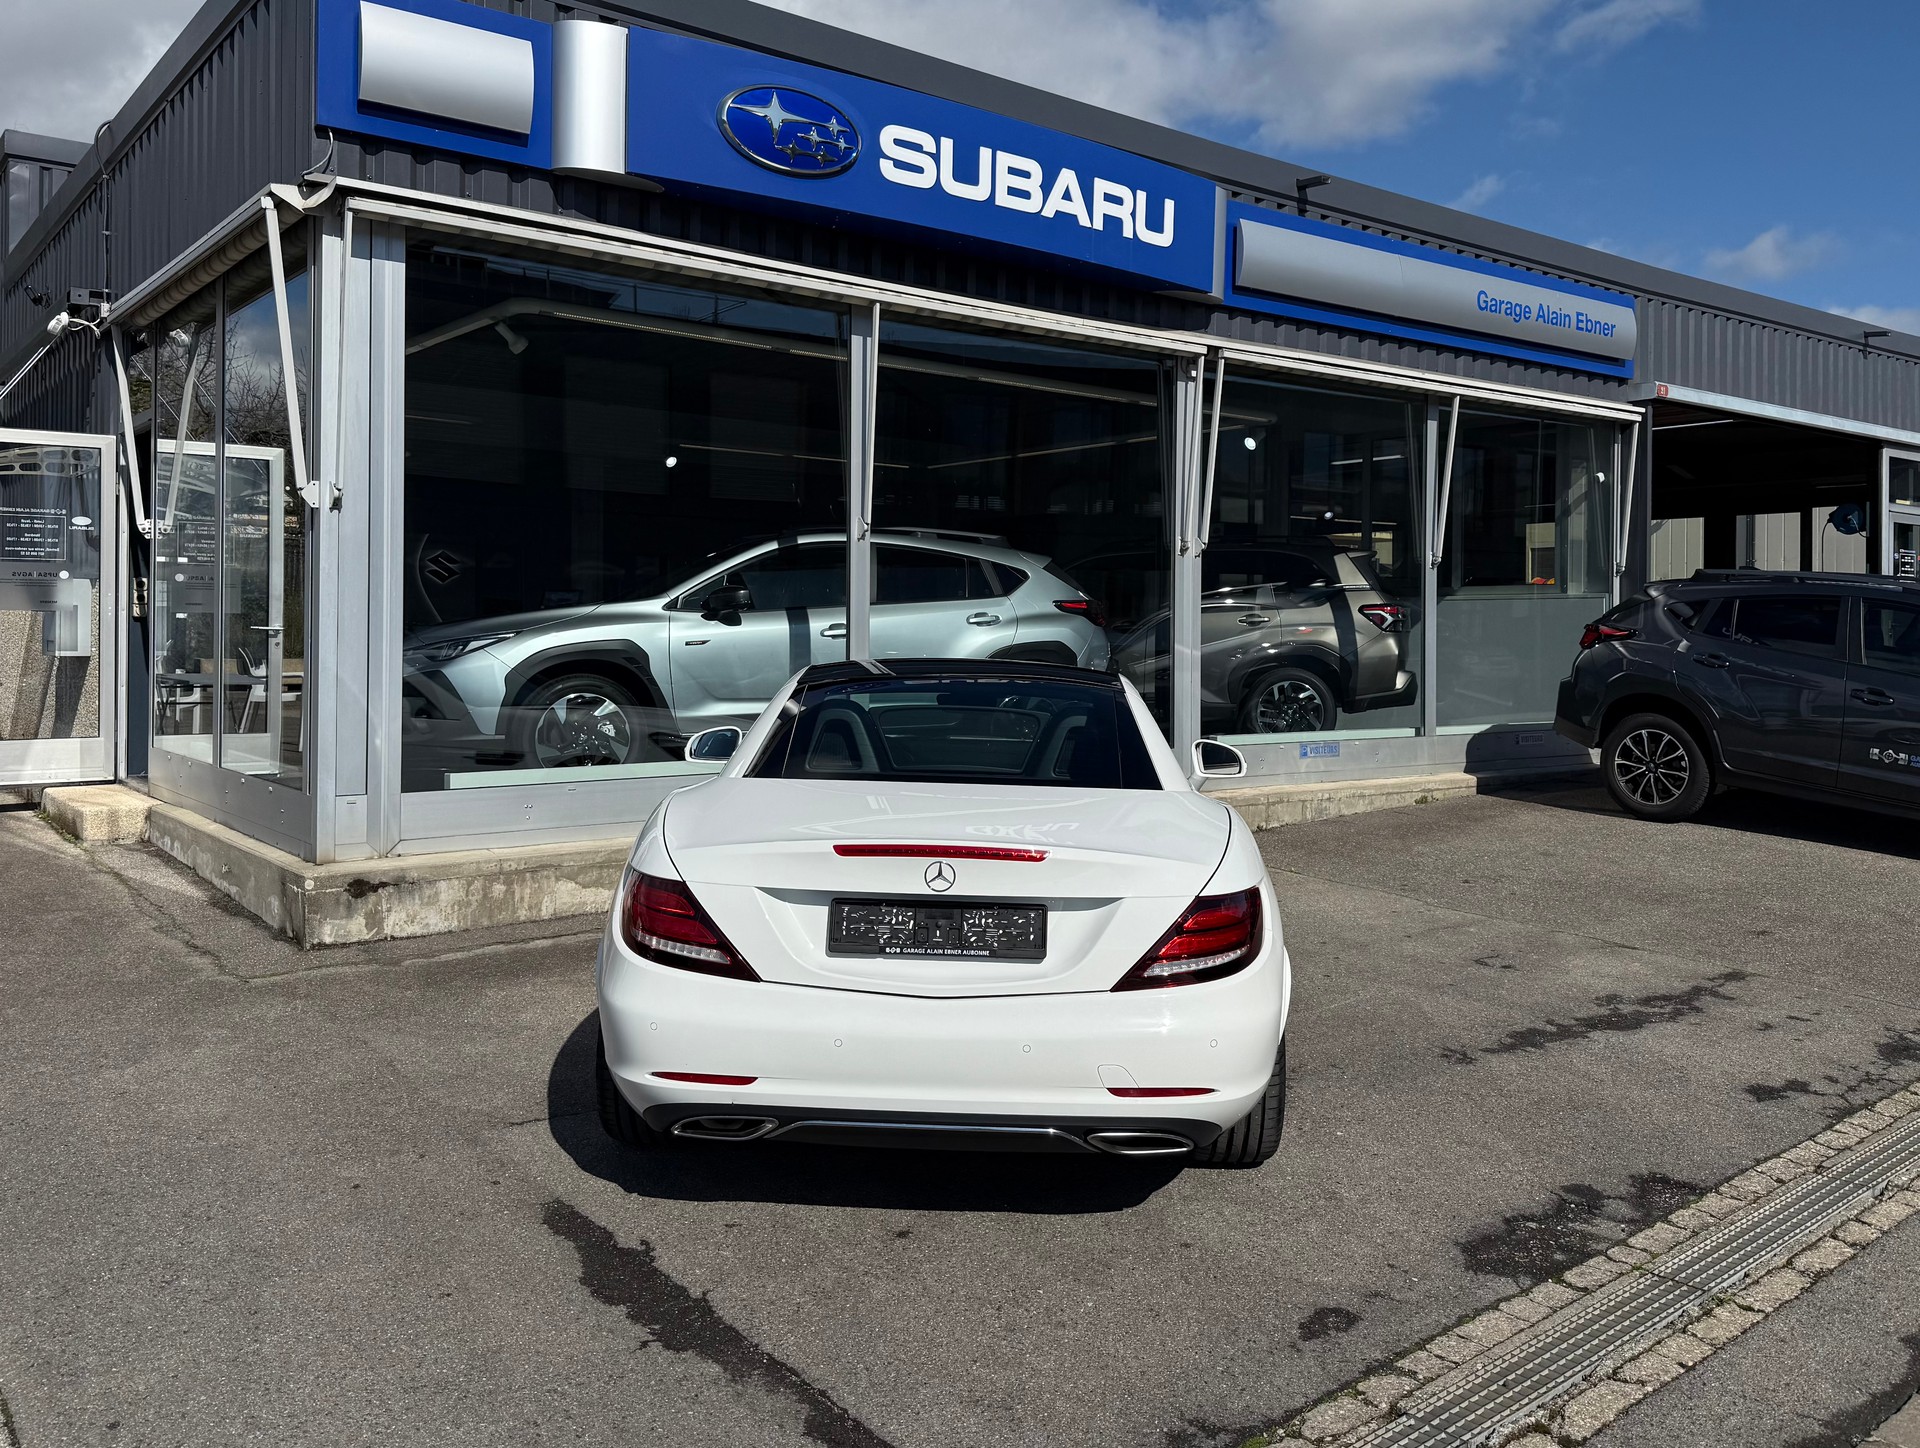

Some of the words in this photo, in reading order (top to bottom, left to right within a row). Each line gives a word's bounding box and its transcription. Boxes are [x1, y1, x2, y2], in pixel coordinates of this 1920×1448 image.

[879, 124, 1175, 248] SUBARU
[1477, 290, 1532, 323] Garage
[1535, 303, 1572, 329] Alain
[1575, 311, 1617, 338] Ebner
[1309, 744, 1339, 755] VISITEURS
